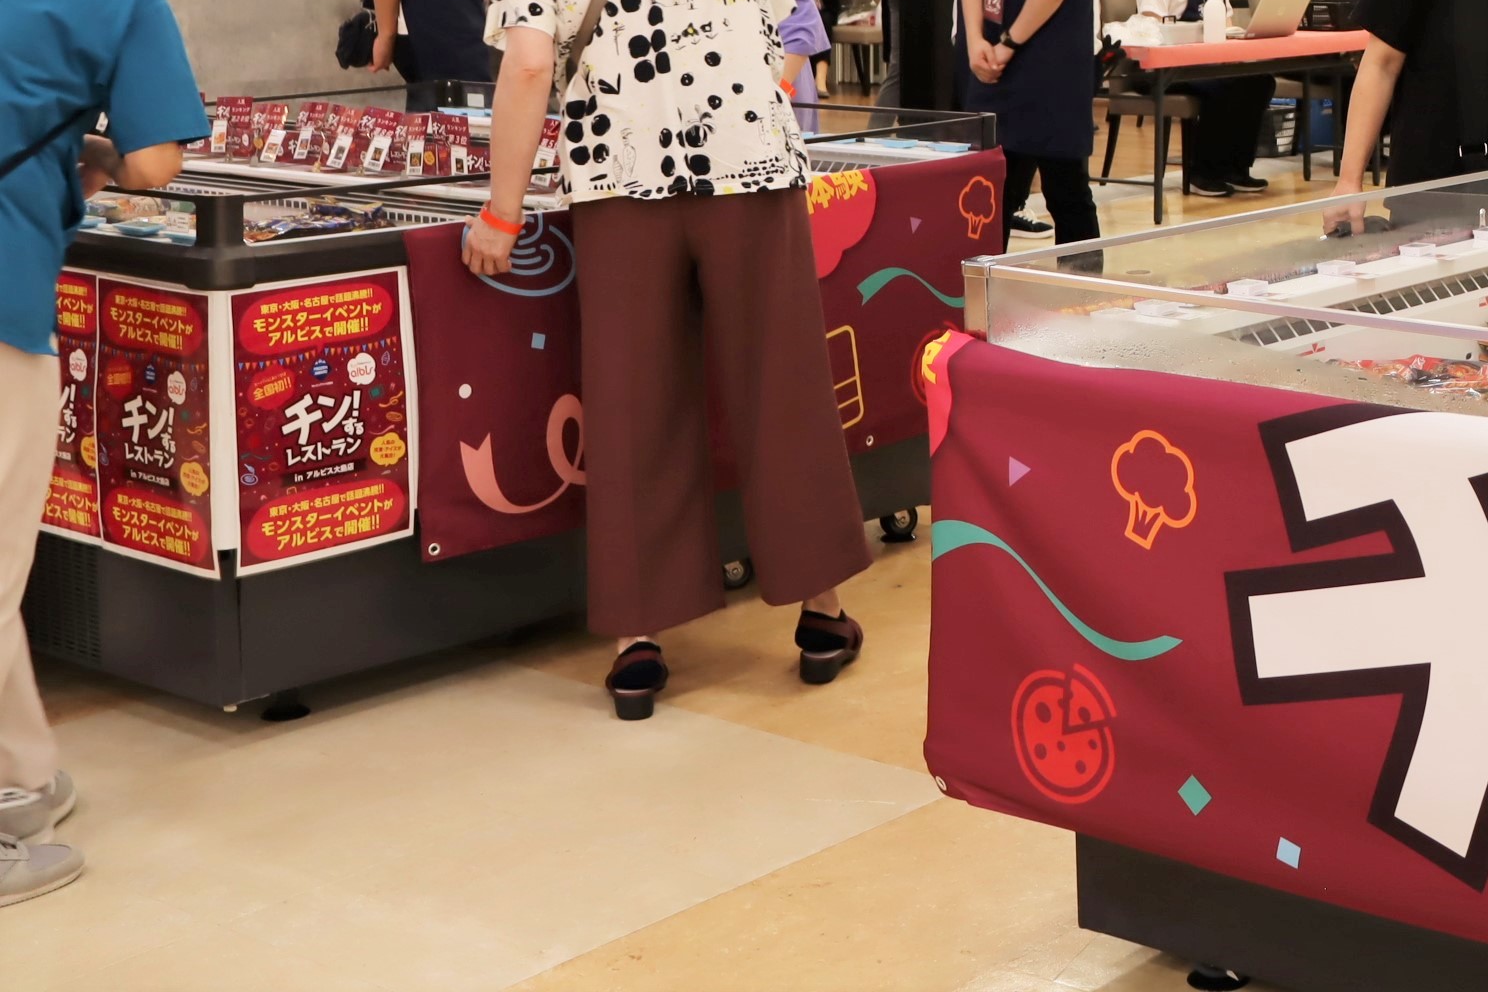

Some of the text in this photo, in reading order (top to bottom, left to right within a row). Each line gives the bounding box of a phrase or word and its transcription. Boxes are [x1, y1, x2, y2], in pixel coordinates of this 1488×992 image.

[110, 307, 193, 335] モンスターイベントが
[253, 302, 382, 332] モンスターイベントが
[268, 317, 369, 346] アルビスで開催!!
[119, 324, 183, 350] アルビスで開催!!
[122, 395, 174, 443] チン!
[281, 390, 361, 445] チン!
[124, 442, 174, 469] レストラン
[286, 439, 361, 466] レストラン
[295, 463, 355, 482] in アルビス大島店
[112, 506, 199, 542] モンスターイベントが
[262, 498, 393, 536] モンスターイベントが
[277, 514, 380, 550] アルビスで開催!!
[122, 525, 191, 557] アルビスで開催!!
